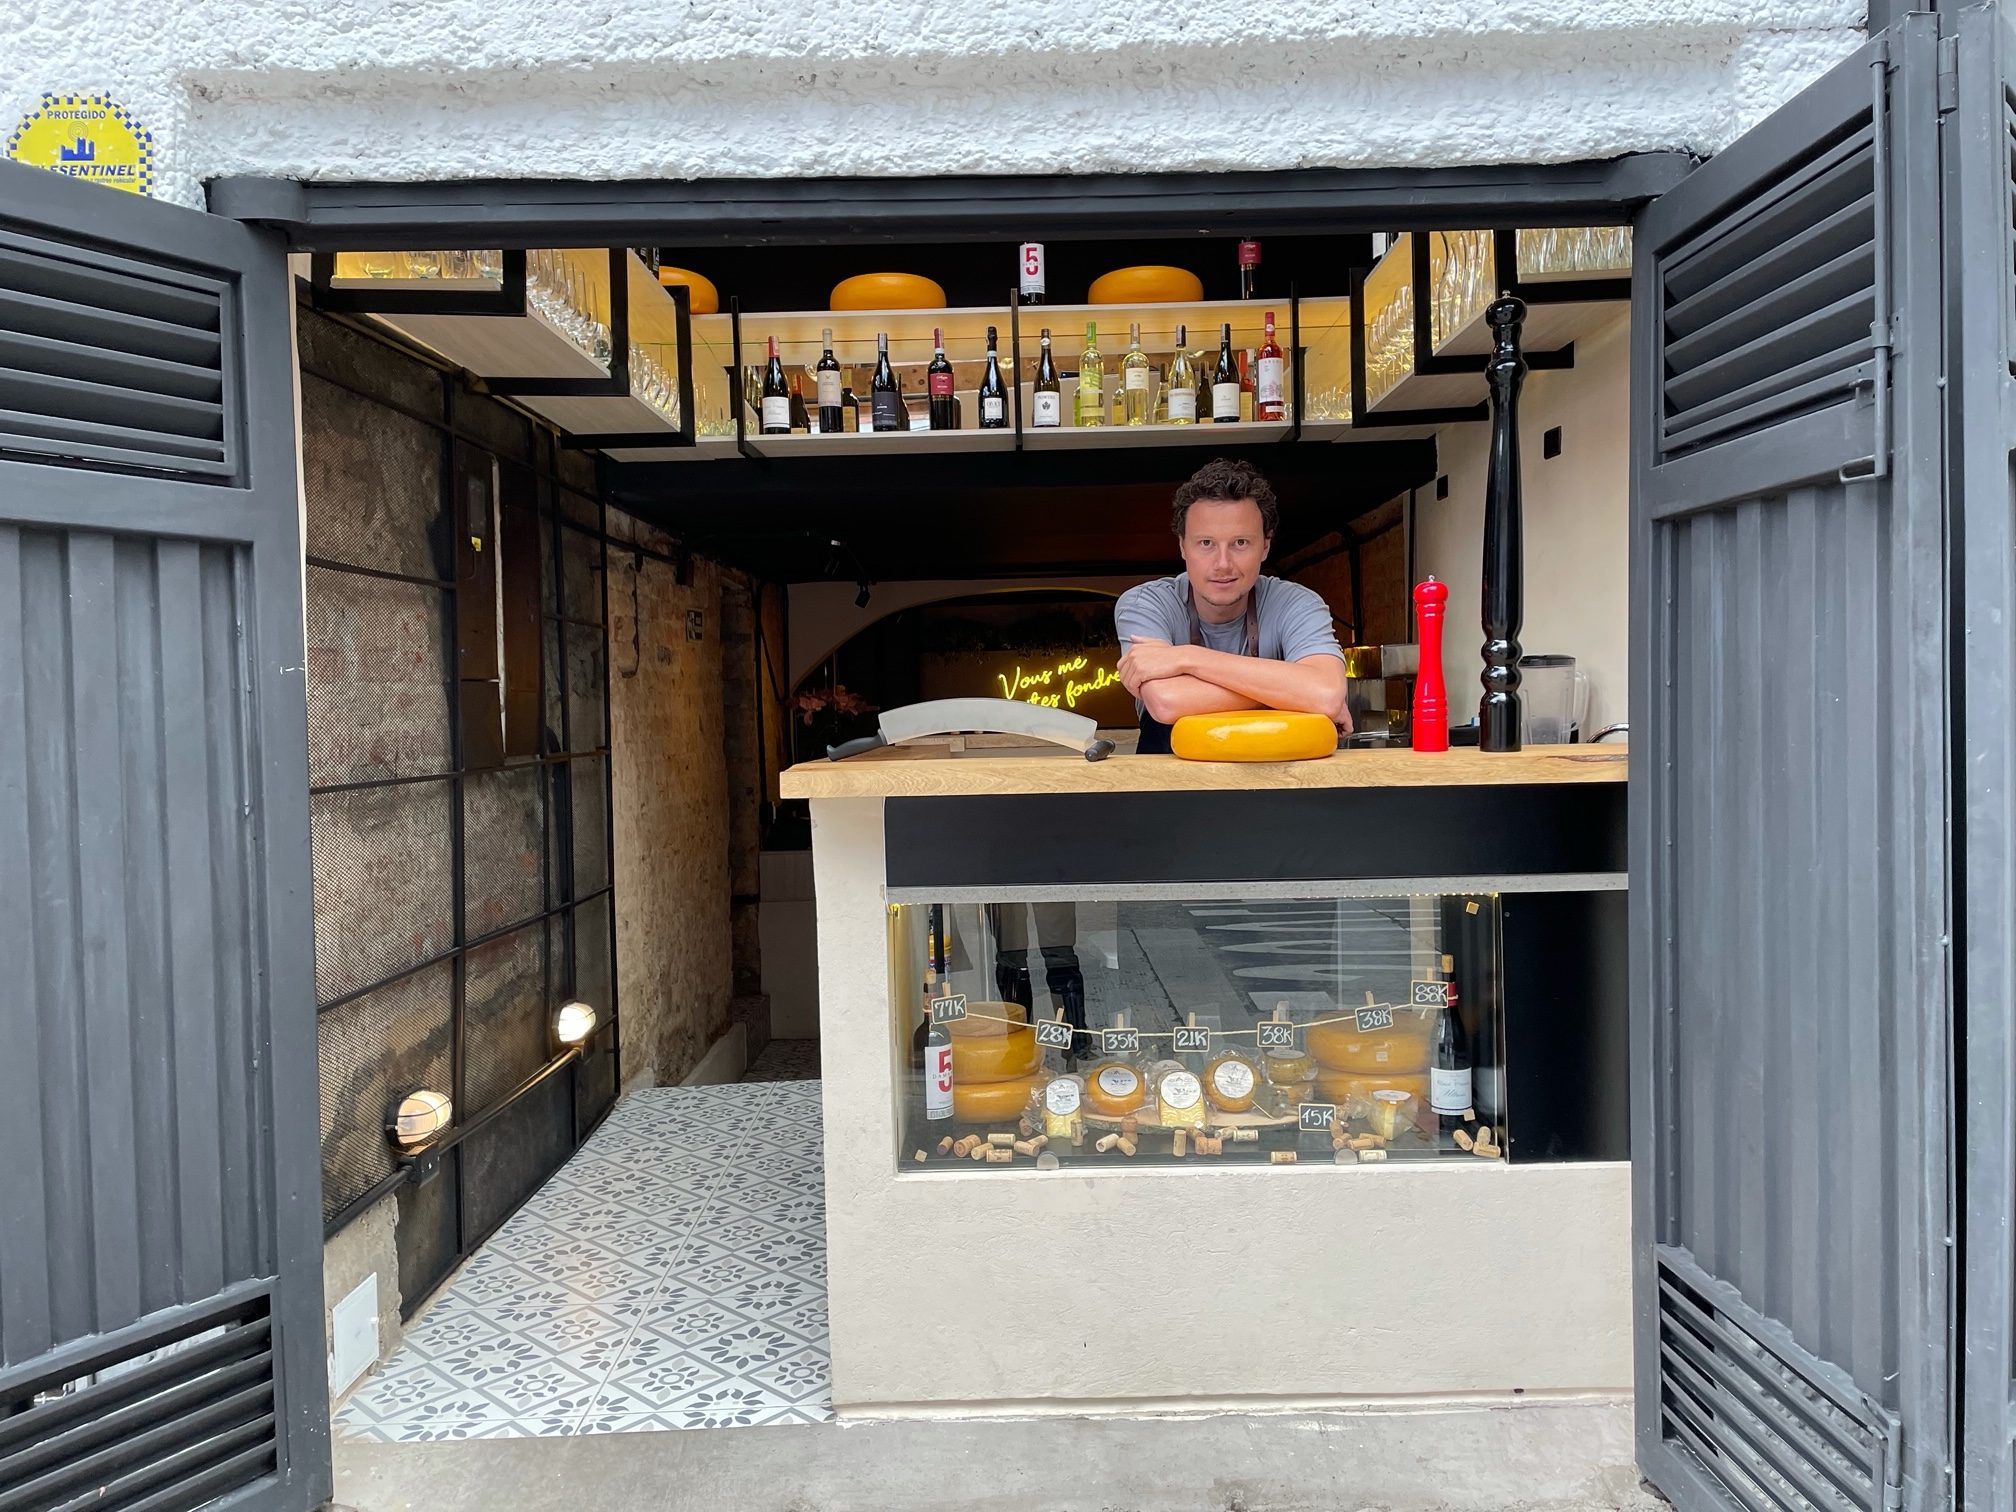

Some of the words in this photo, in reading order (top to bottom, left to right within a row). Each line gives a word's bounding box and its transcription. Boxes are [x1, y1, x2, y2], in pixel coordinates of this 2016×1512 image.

[47, 110, 106, 120] PROTEGIDO
[42, 164, 136, 177] ESENTINEL
[1025, 247, 1039, 276] 5
[998, 665, 1053, 700] Vous
[1057, 656, 1088, 675] me
[1415, 983, 1448, 1003] 88K
[934, 996, 966, 1018] 77K
[1358, 1008, 1393, 1030] 38K
[1037, 1023, 1073, 1044] 28K
[1105, 1032, 1137, 1049] 35K
[1177, 1030, 1208, 1047] 21K
[938, 1049, 952, 1093] 5
